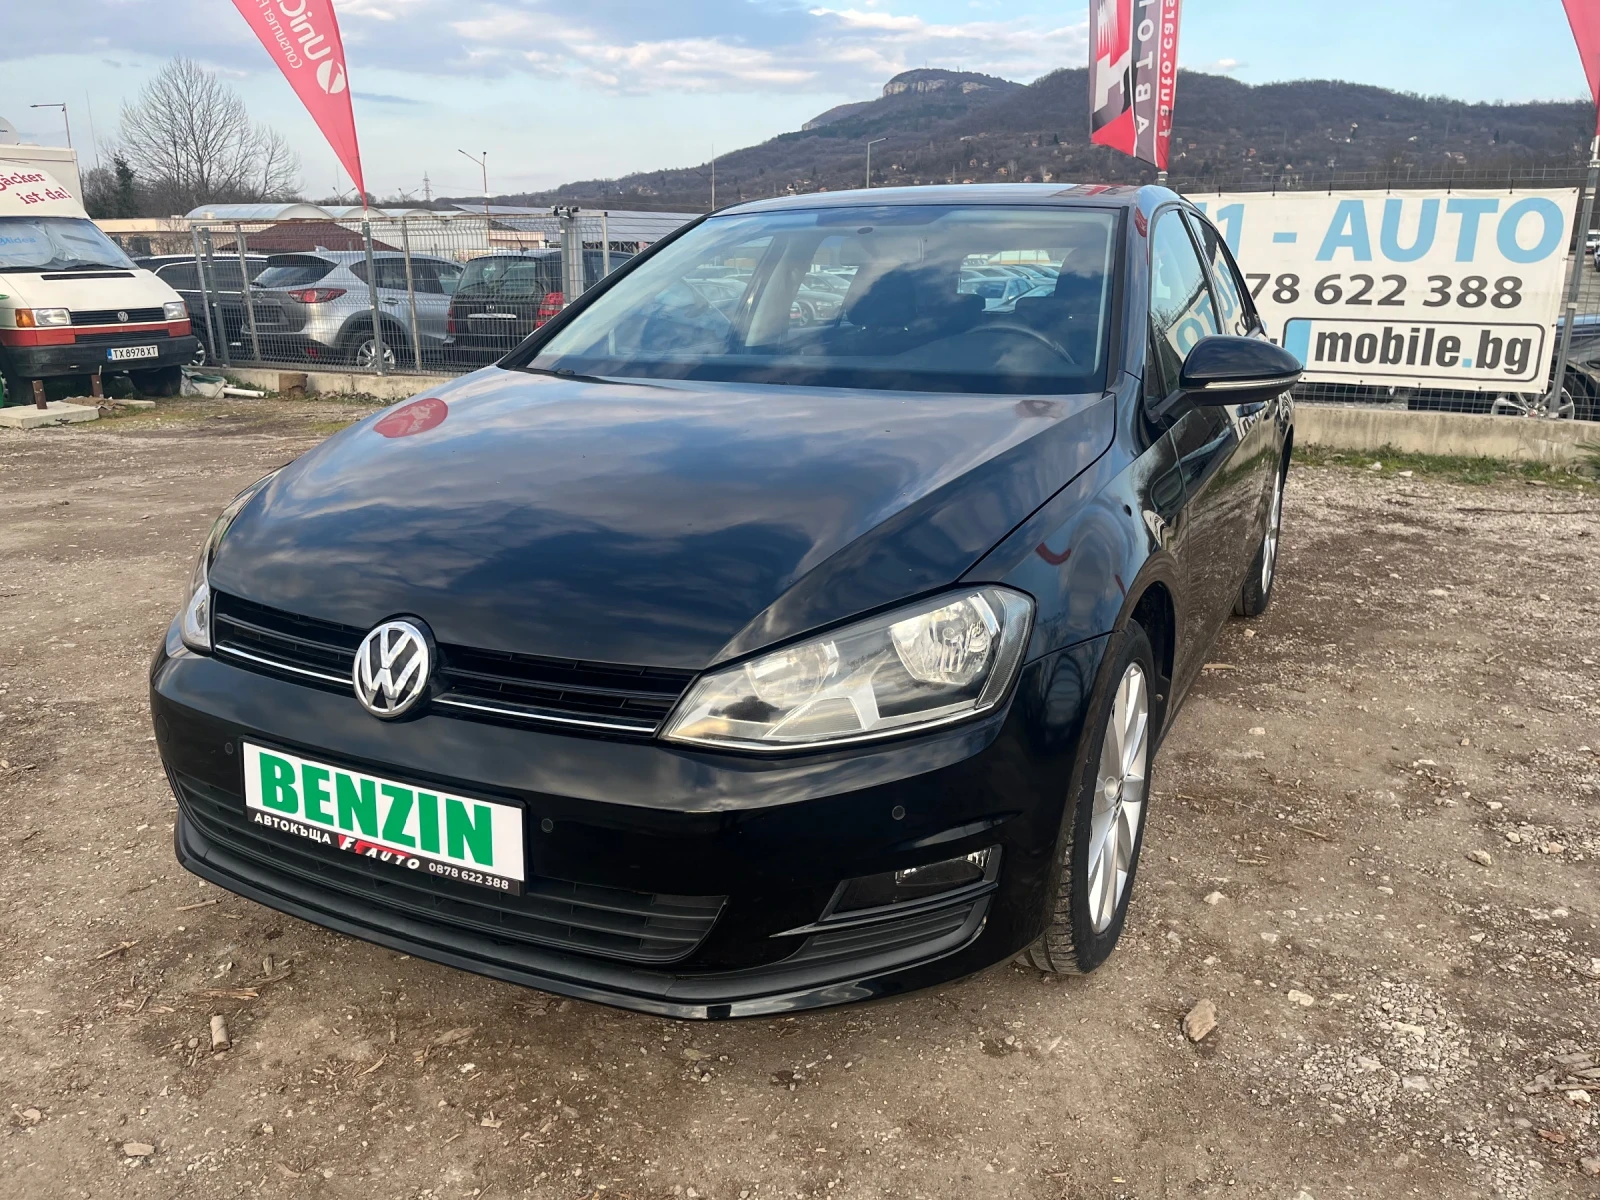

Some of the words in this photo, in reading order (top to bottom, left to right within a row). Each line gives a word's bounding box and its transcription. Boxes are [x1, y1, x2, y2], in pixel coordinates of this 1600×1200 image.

[16, 192, 45, 205] ist
[45, 186, 72, 200] da!
[1193, 202, 1245, 261] 1
[1273, 233, 1297, 243] -
[1316, 198, 1565, 263] AUTO
[1315, 273, 1408, 306] 622
[1423, 275, 1523, 308] 388
[112, 349, 124, 359] TX
[126, 348, 146, 358] 8978
[146, 346, 157, 356] XT
[1315, 327, 1532, 374] mobile.bg
[259, 752, 493, 867] BENZIN
[254, 812, 332, 845] АВТОКЪЩА
[365, 848, 420, 870] AUTO
[428, 863, 459, 878] 0878
[461, 870, 483, 884] 622
[485, 876, 509, 890] 388
